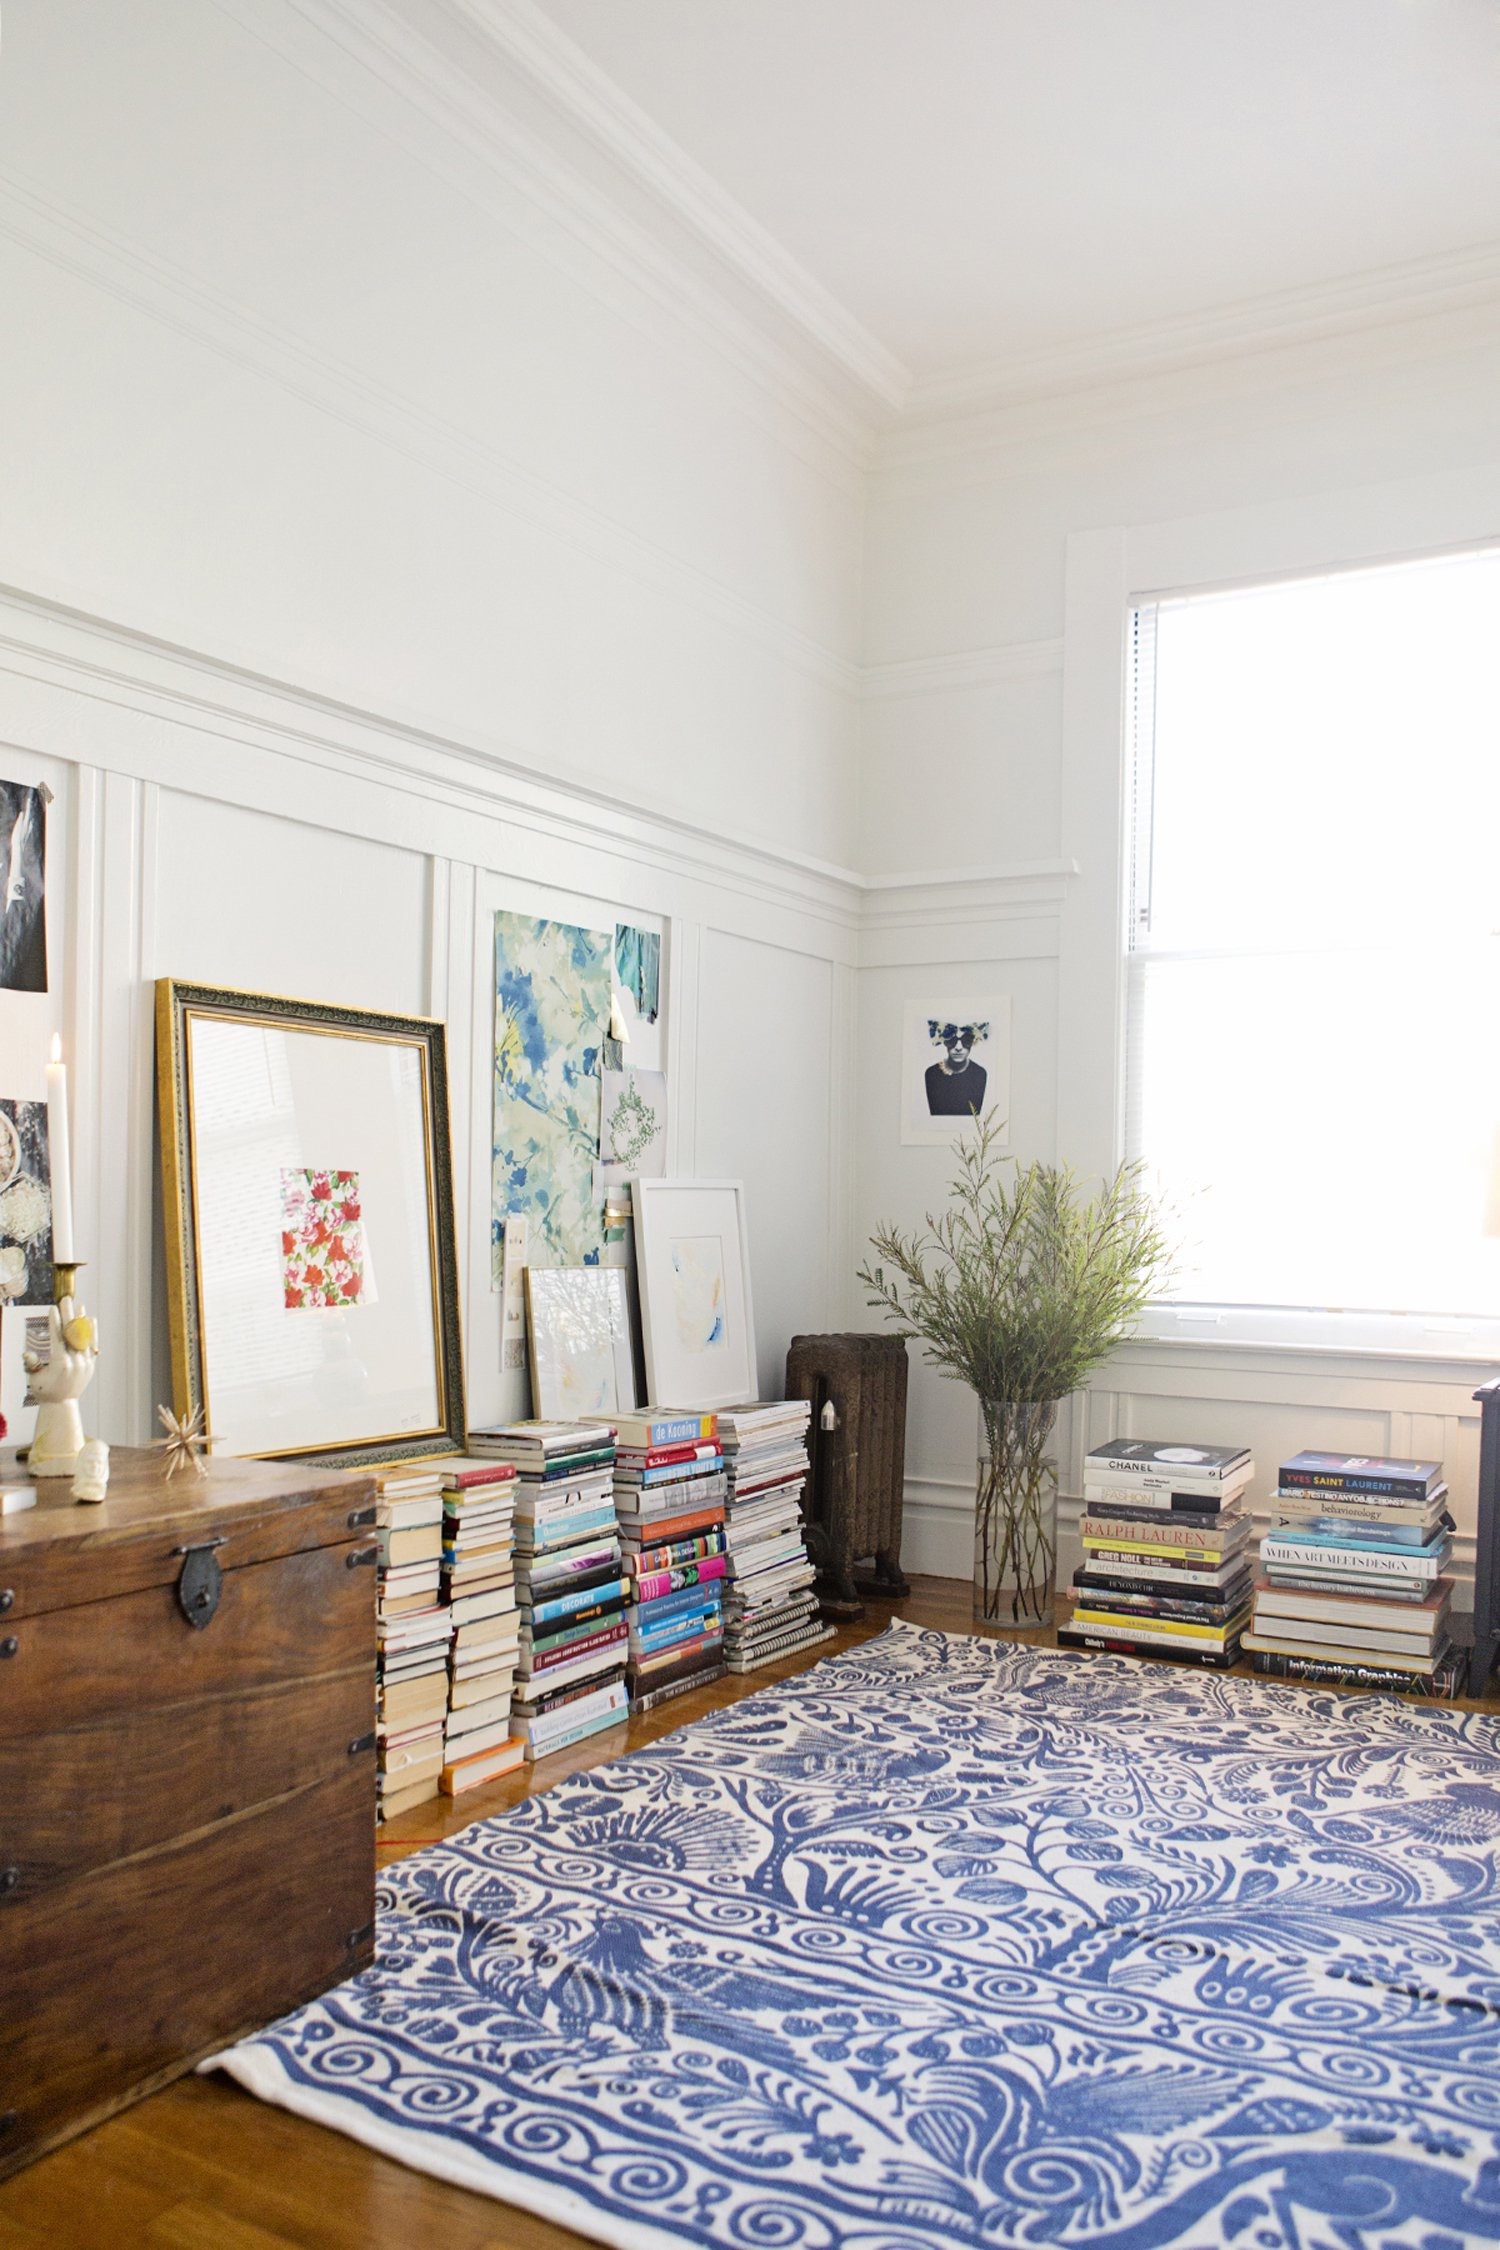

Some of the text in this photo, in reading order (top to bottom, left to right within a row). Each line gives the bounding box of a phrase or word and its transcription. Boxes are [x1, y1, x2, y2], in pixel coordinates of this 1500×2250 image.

[656, 1420, 697, 1440] de Kooning
[1108, 1459, 1154, 1473] CHANEL
[1285, 1473, 1393, 1492] YVES SAINT LAURENT
[1103, 1487, 1152, 1505] FASHION
[1280, 1487, 1305, 1498] MARIO
[1306, 1490, 1338, 1502] TESTINO
[1337, 1493, 1354, 1503] ANY
[1320, 1502, 1382, 1521] behaviorology
[1084, 1520, 1207, 1546] RALPH LAUREN
[1097, 1550, 1119, 1563] GREG
[1120, 1552, 1141, 1564] NOLL
[1265, 1547, 1408, 1571] WHEN ART MEETS DESIGN
[1096, 1563, 1154, 1577] architecture
[561, 1593, 595, 1612] DECORATE
[1076, 1623, 1119, 1637] AMERICAN
[1120, 1628, 1154, 1641] BEAUTY
[1288, 1659, 1356, 1676] Information
